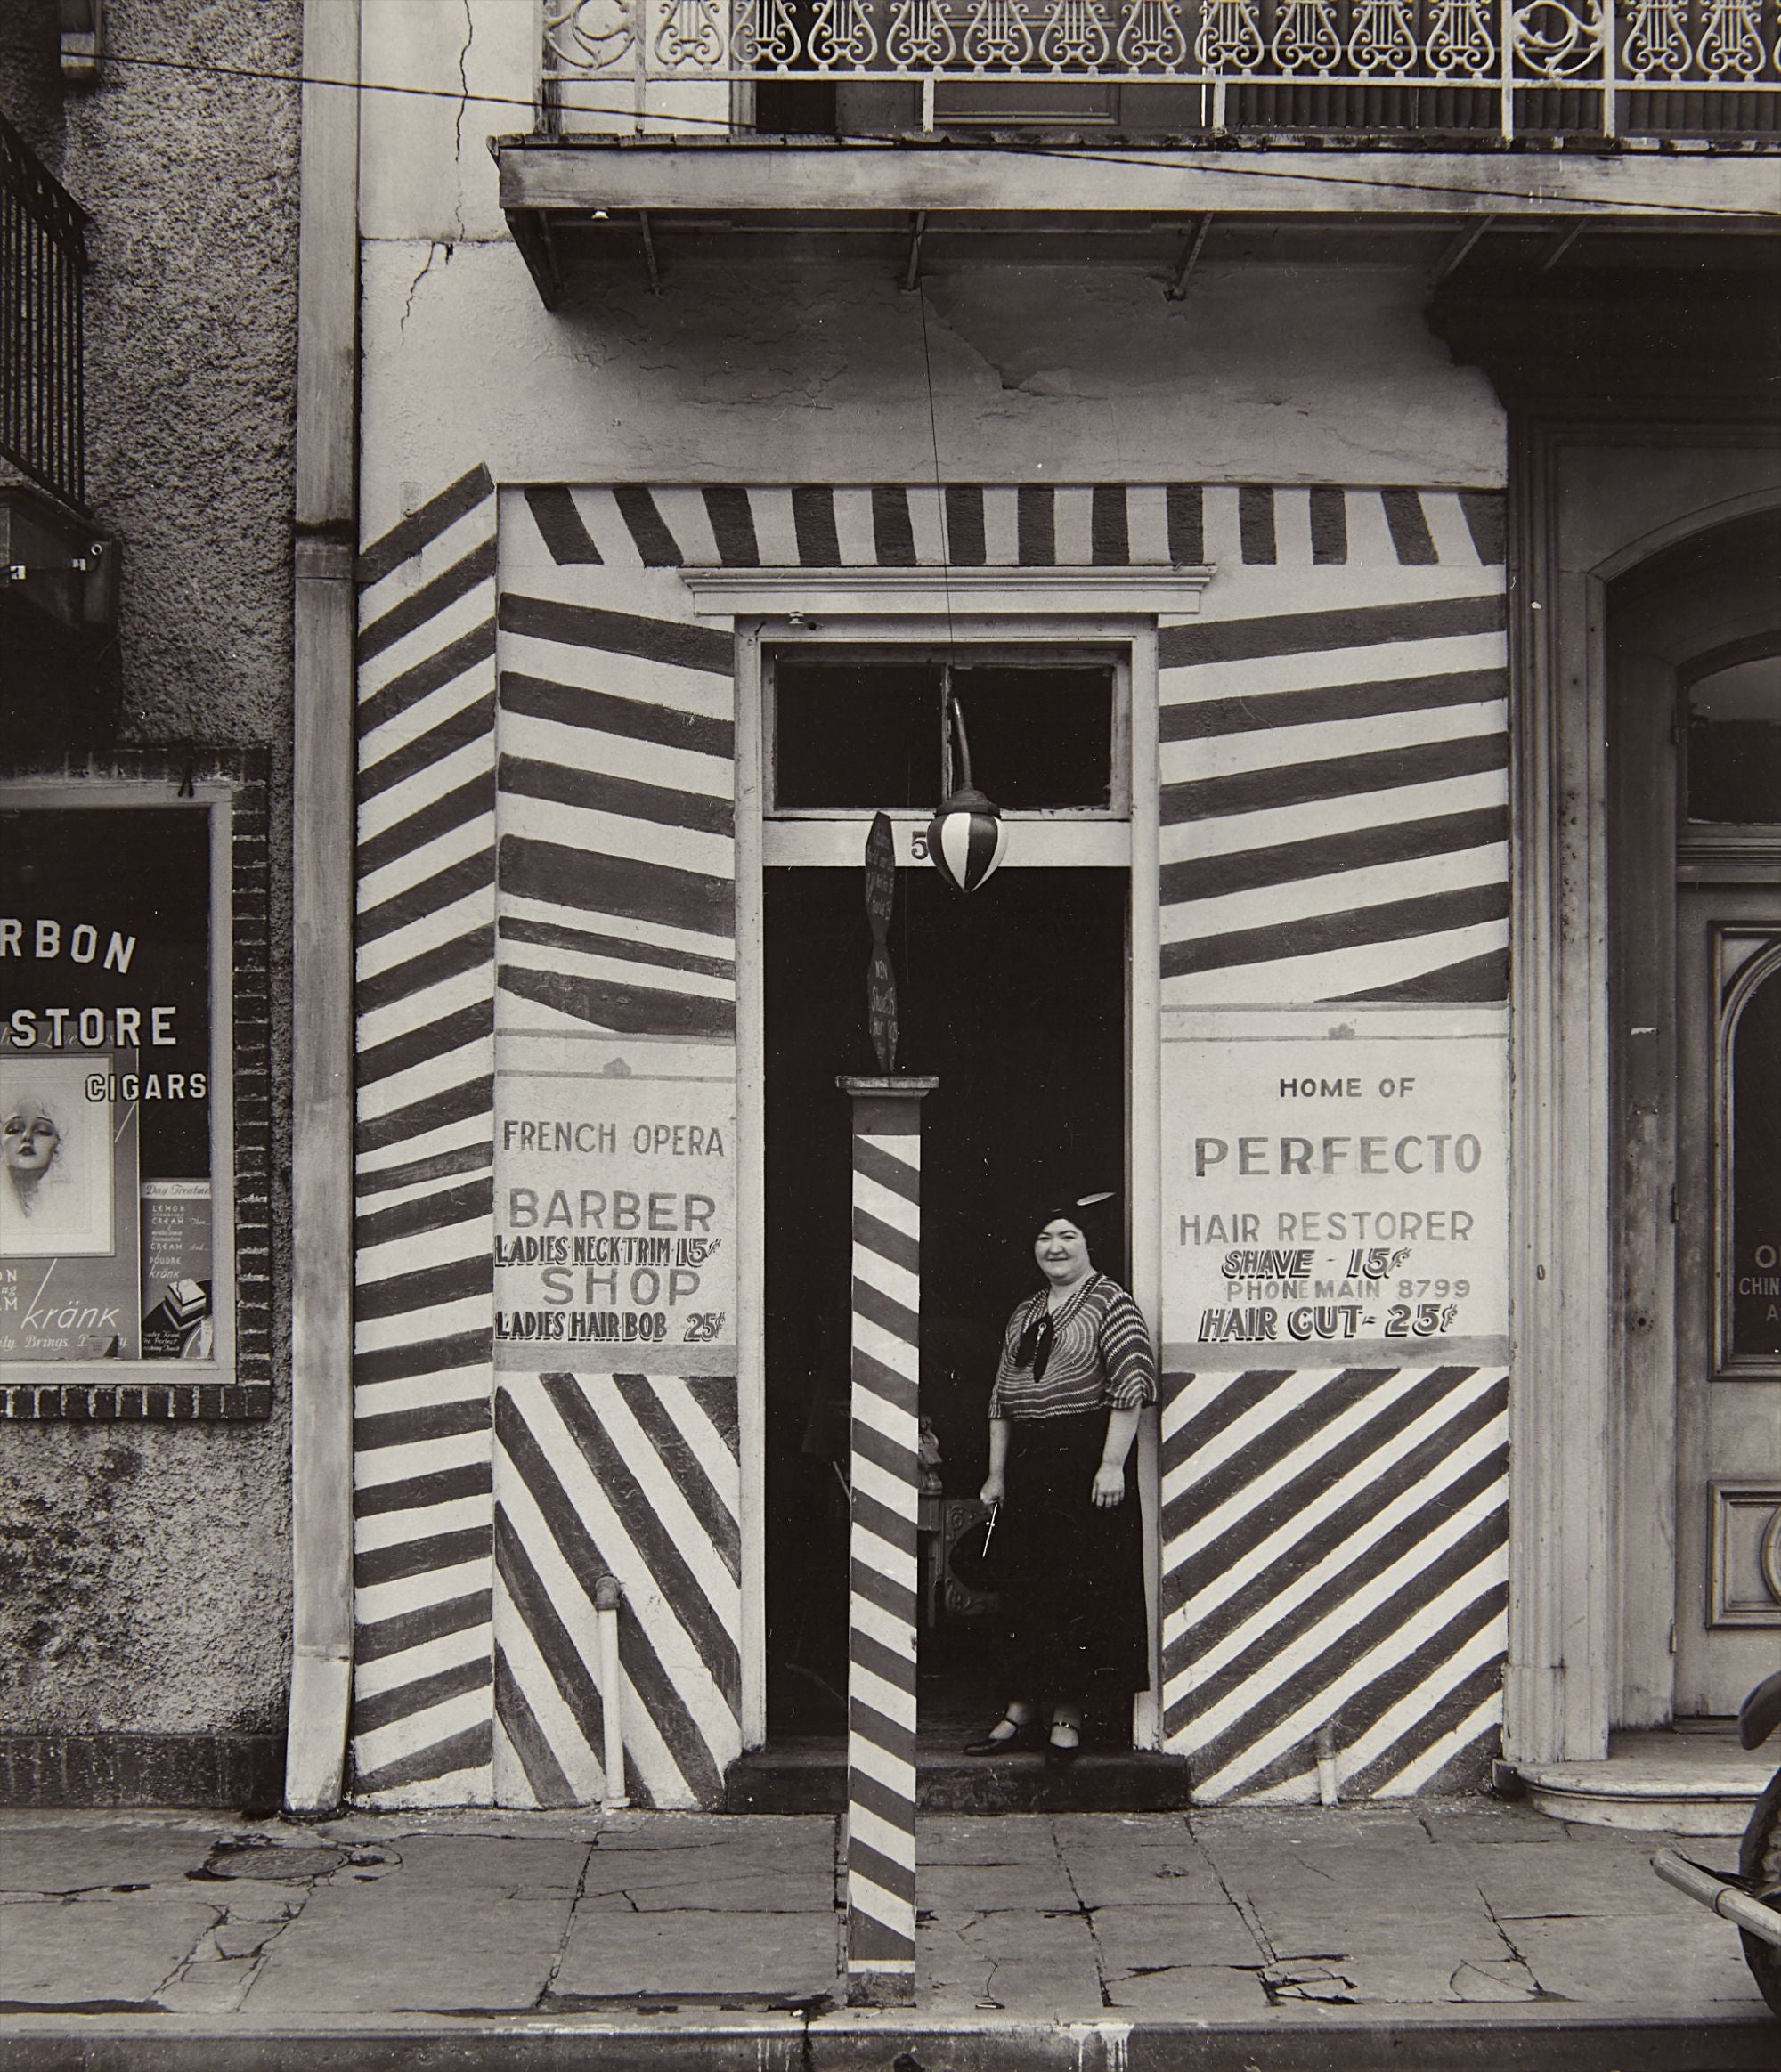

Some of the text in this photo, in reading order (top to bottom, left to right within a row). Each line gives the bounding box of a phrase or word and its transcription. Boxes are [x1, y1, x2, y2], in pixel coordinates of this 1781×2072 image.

[911, 831, 928, 860] 5
[11, 1006, 176, 1048] STORE
[85, 1073, 207, 1101] CIGARS
[1280, 1077, 1416, 1098] HOME OF
[503, 1120, 724, 1157] FRENCH OPERA
[1195, 1134, 1482, 1177] PERFECTO
[509, 1188, 716, 1231] BARBER
[1179, 1210, 1475, 1246] HAIR RESTORER
[150, 1256, 182, 1264] POUDRE
[1221, 1248, 1314, 1280] SHAVE
[1755, 1244, 1781, 1268] O
[0, 1269, 17, 1282] N
[541, 1266, 702, 1306] SHOP
[1226, 1279, 1472, 1301] PHONE MAIN 8799
[1739, 1277, 1780, 1296] CHIN
[0, 1296, 18, 1311] M
[495, 1311, 565, 1340] LADIES
[622, 1312, 668, 1343] BOB
[1197, 1305, 1278, 1342] HAIR
[0, 1335, 16, 1352] ily
[24, 1335, 70, 1352] Brings
